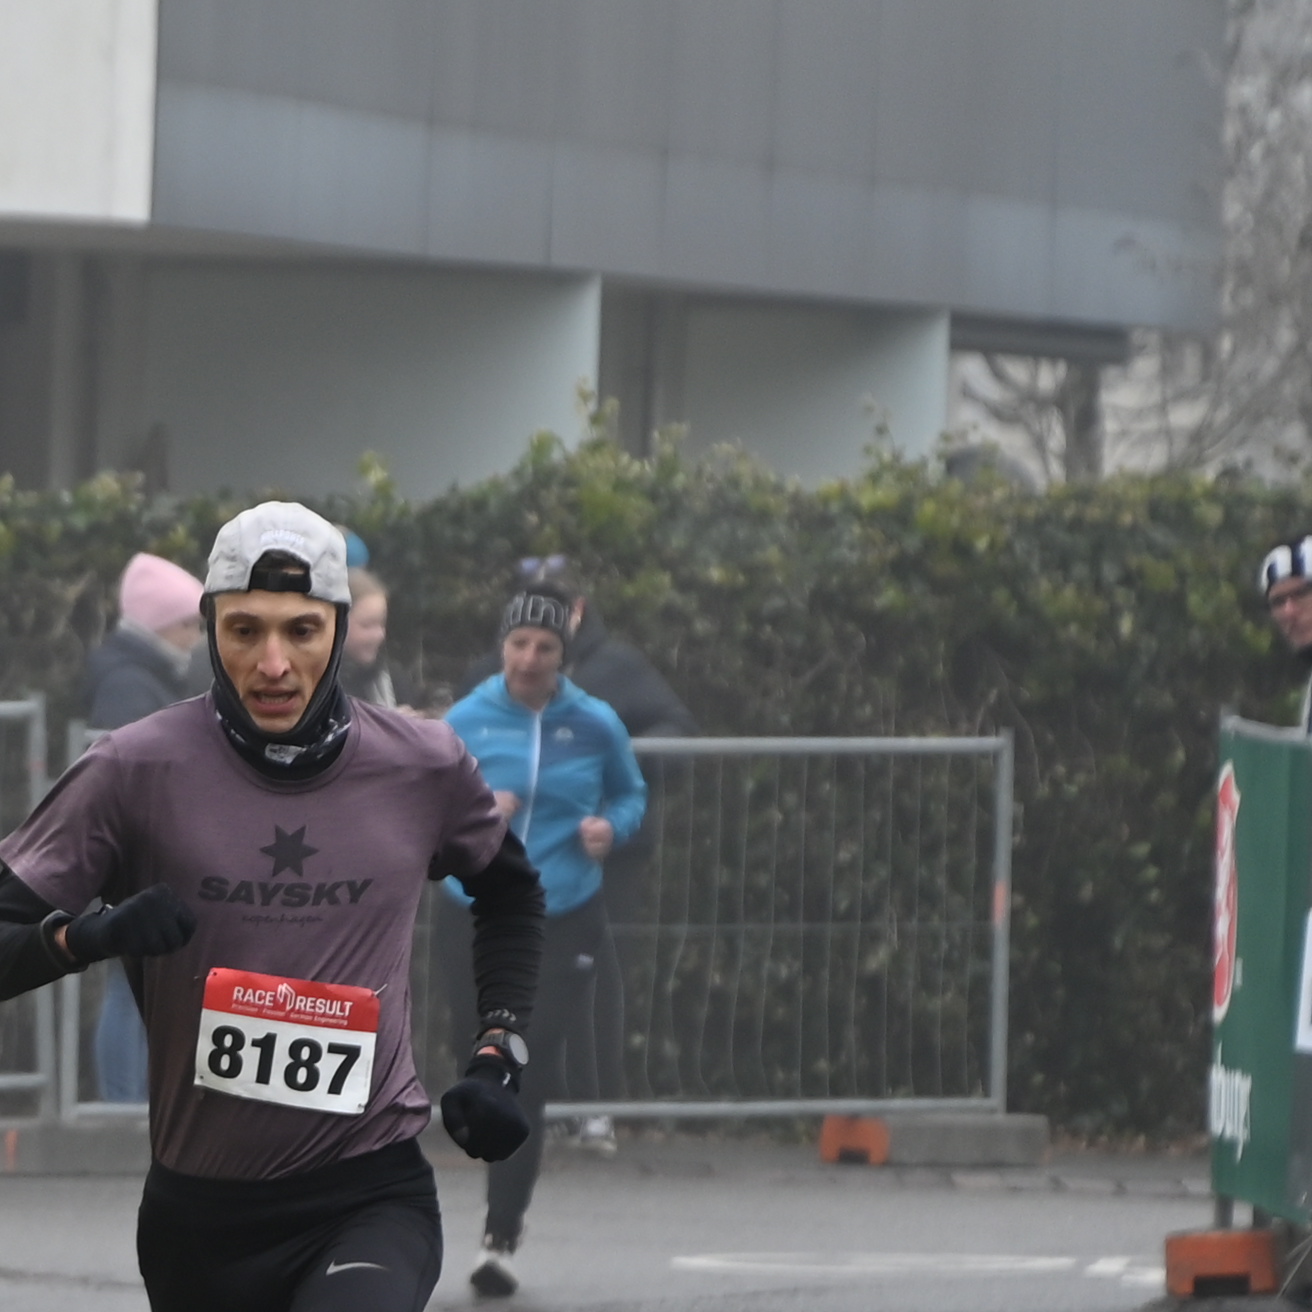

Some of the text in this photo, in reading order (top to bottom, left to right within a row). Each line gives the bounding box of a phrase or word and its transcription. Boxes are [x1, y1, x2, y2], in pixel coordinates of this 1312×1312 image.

[197, 875, 374, 908] SAYSKY
[233, 986, 354, 1017] RACE RESULT
[208, 1025, 362, 1096] 8187
